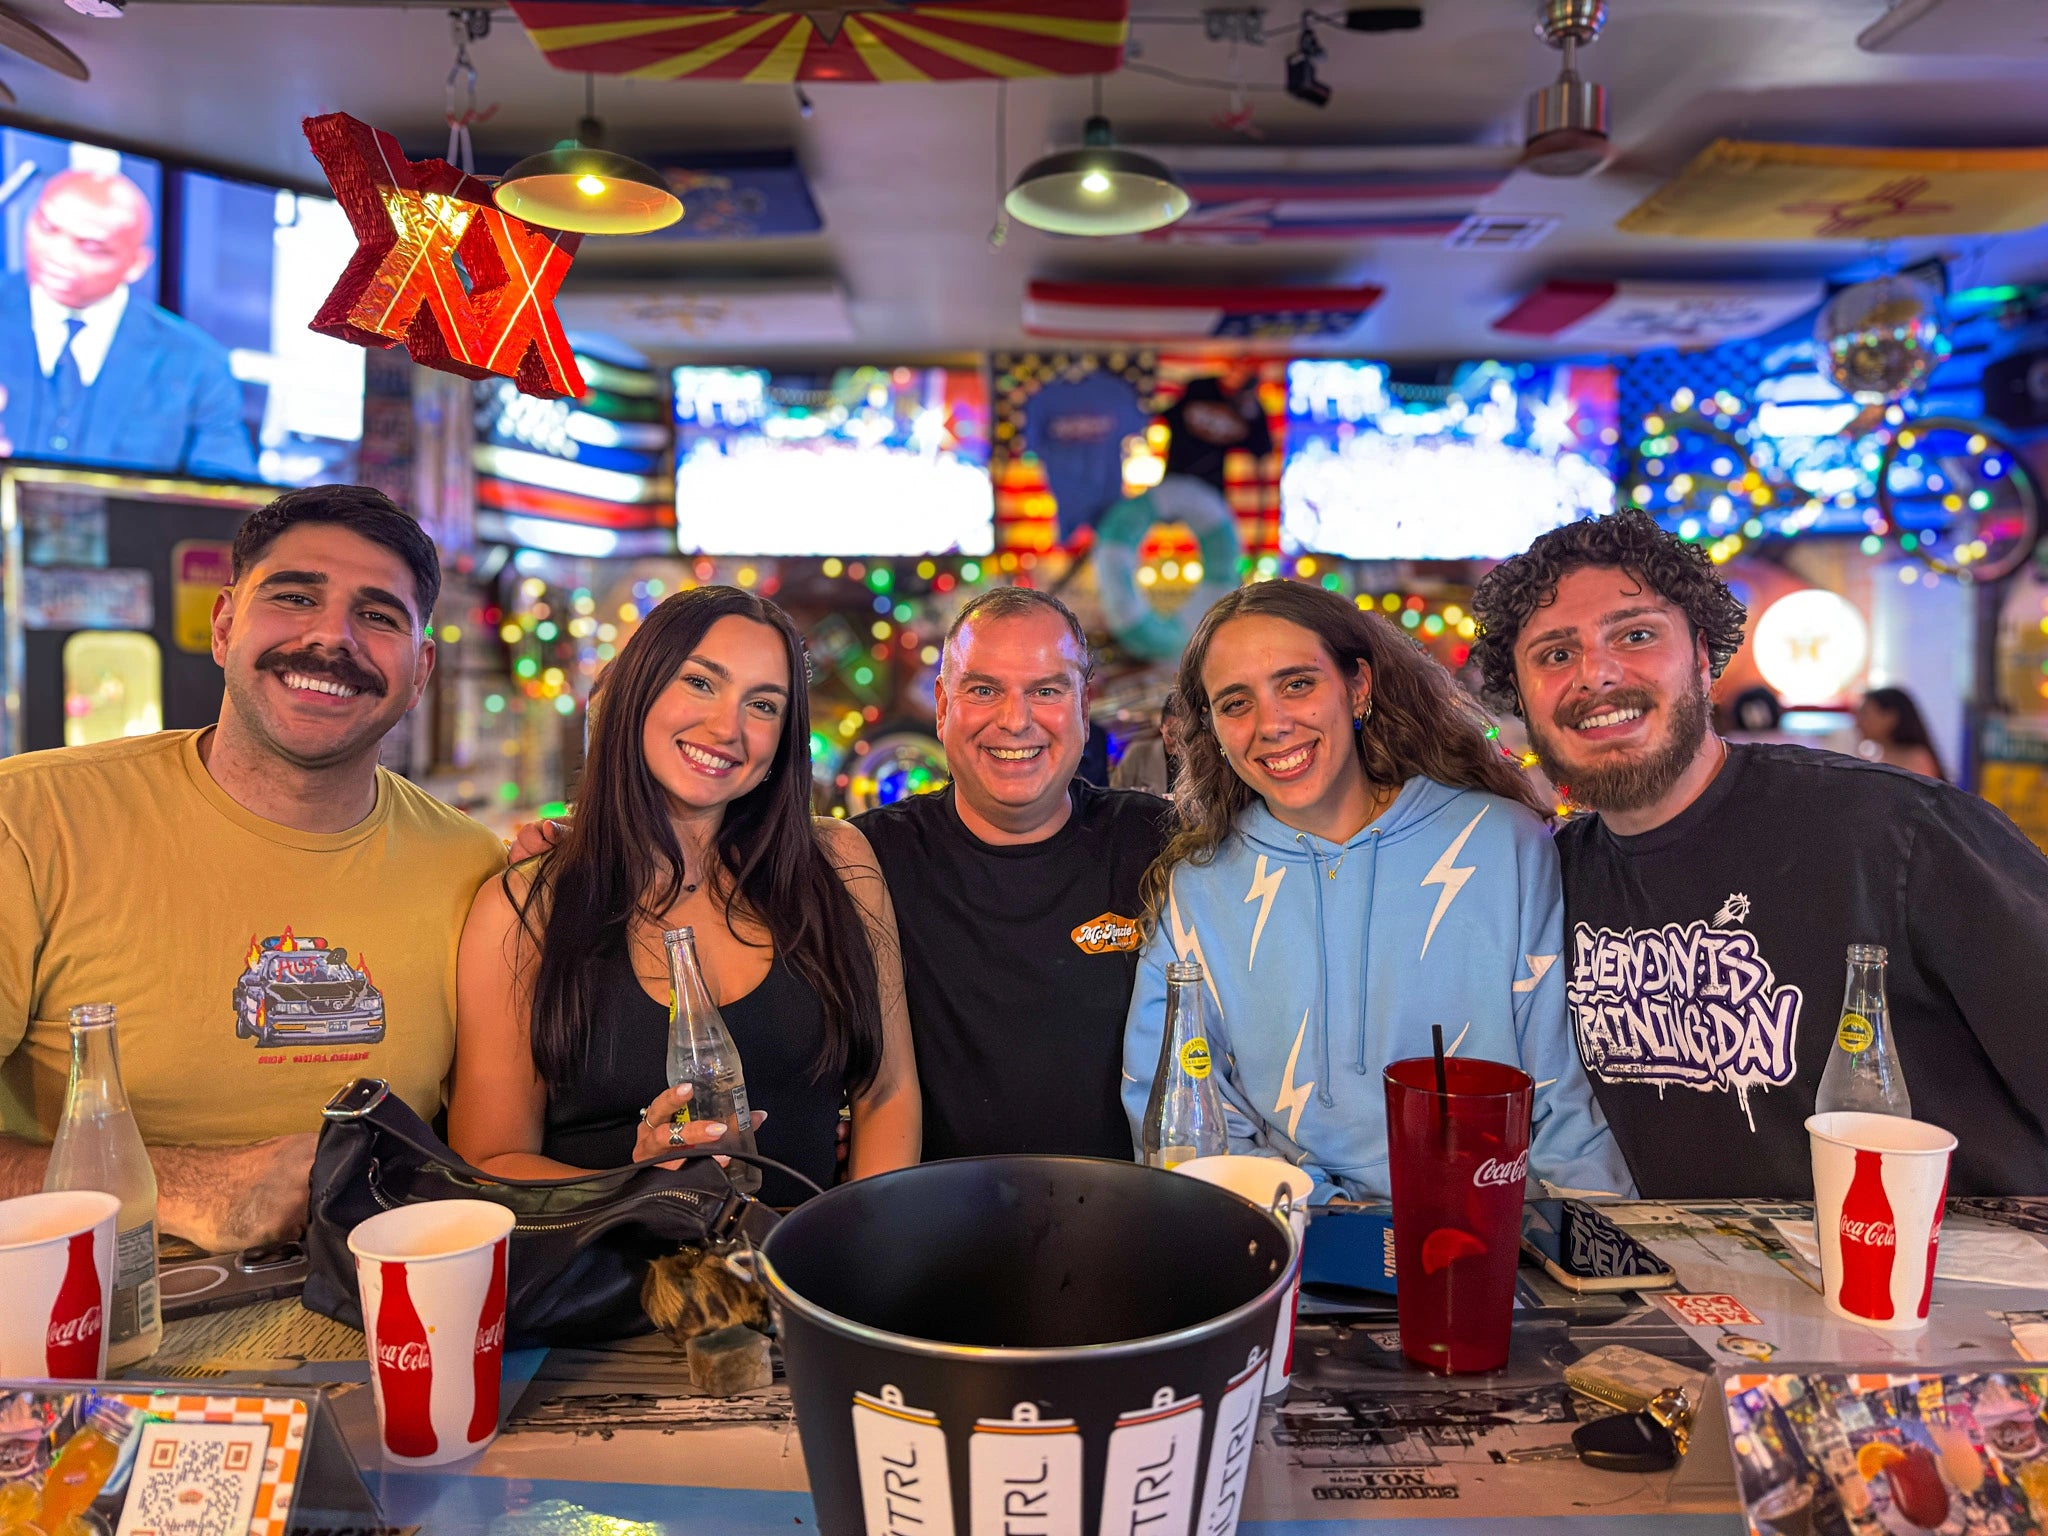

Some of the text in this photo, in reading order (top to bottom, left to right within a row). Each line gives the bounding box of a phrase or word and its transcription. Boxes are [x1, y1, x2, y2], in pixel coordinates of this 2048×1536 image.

[276, 957, 319, 981] HUF
[1707, 996, 1793, 1077] DAY
[881, 1448, 924, 1536] TRL
[1004, 1462, 1049, 1536] TRL
[1131, 1442, 1176, 1536] TRL
[1312, 1486, 1459, 1500] CHEVROLET
